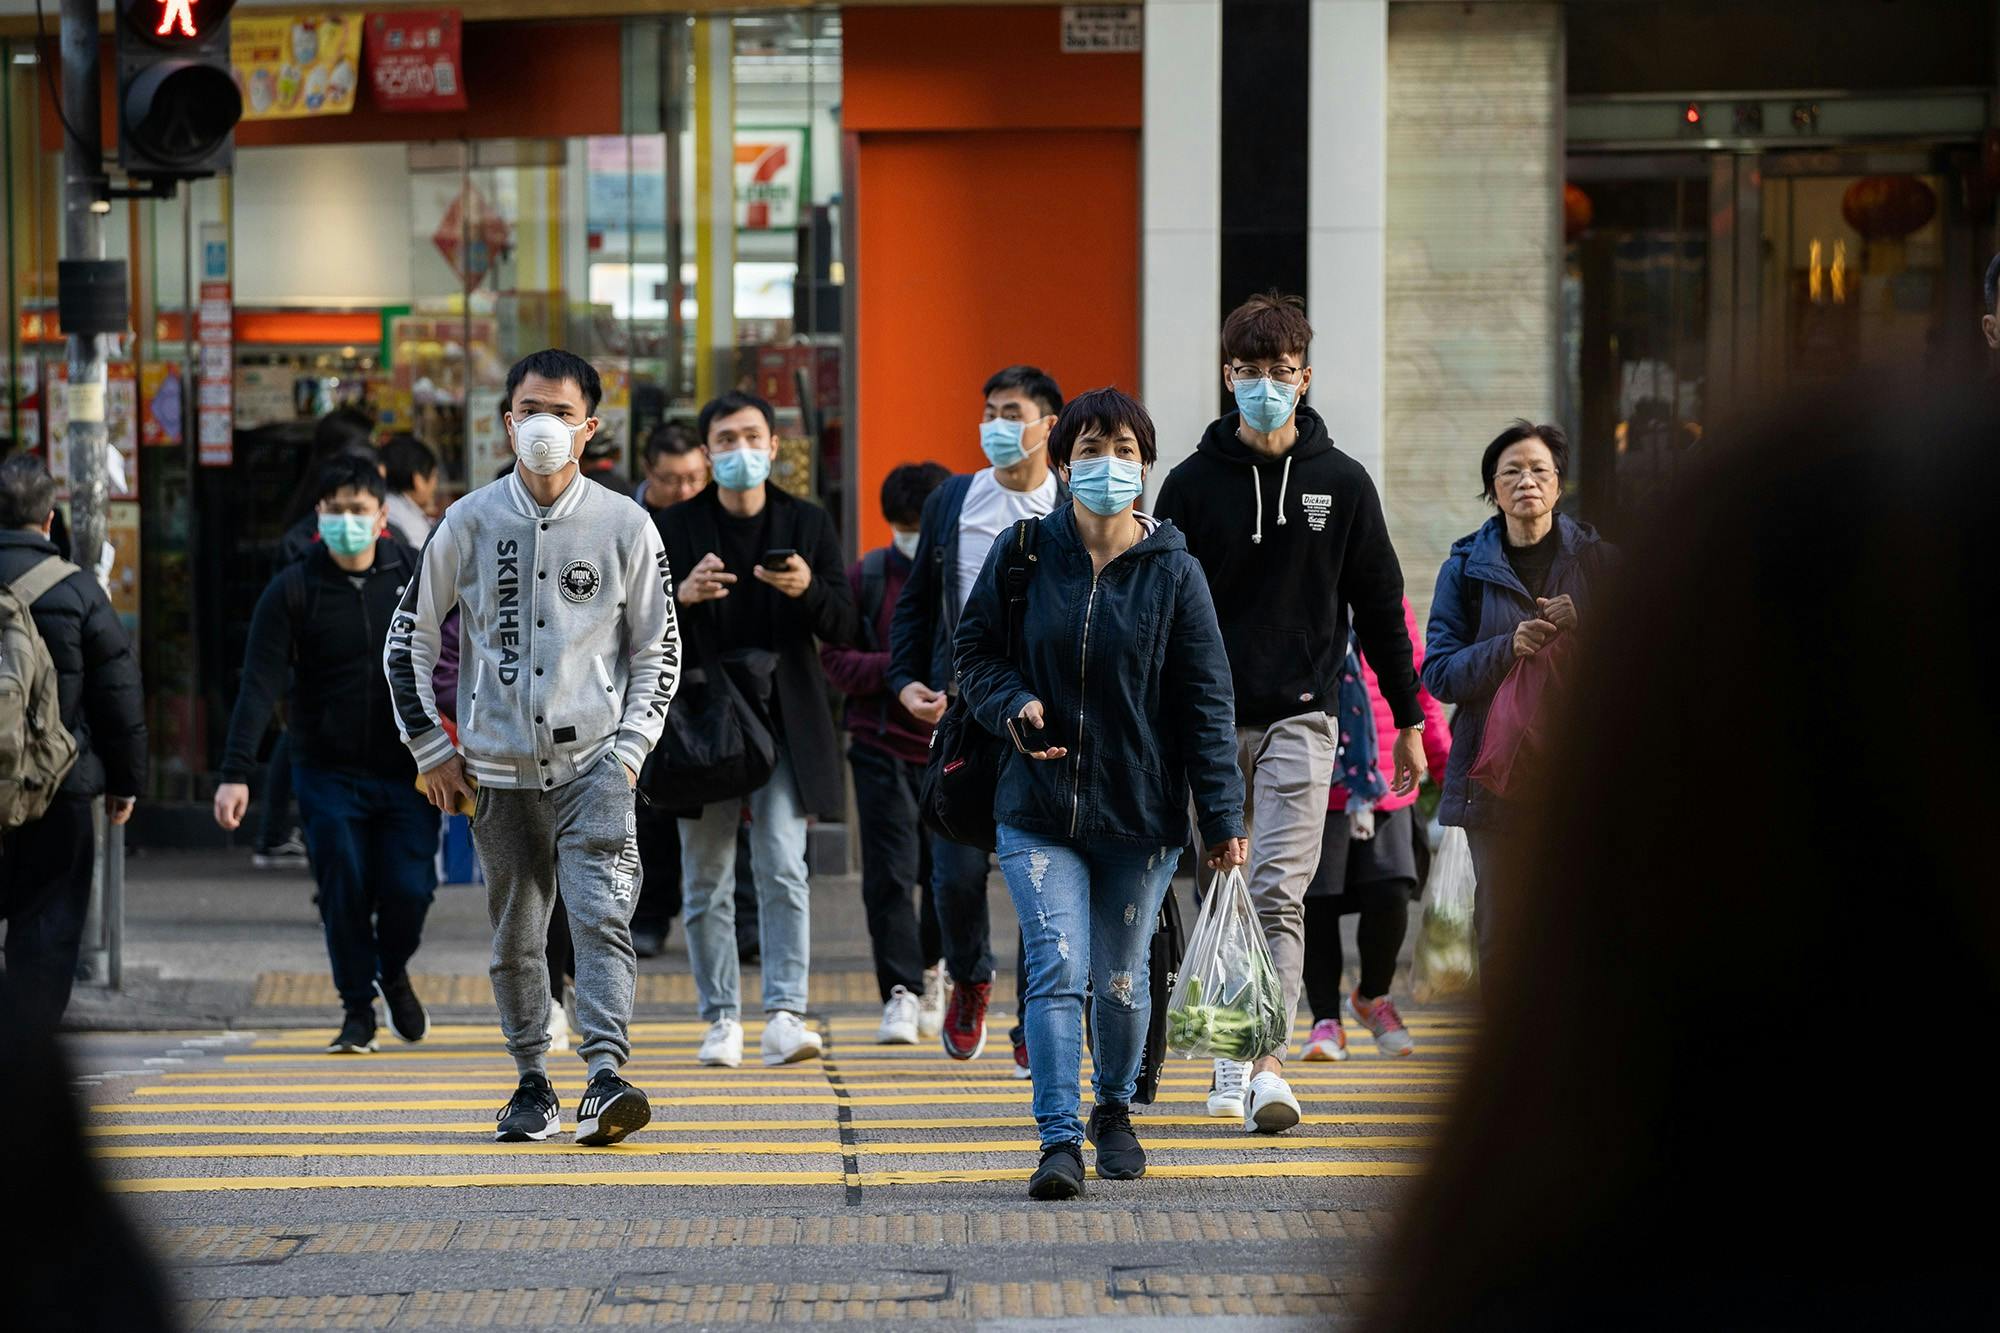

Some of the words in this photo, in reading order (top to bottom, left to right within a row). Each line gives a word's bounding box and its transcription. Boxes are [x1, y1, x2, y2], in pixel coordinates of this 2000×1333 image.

[1303, 495, 1330, 505] Dickies
[497, 540, 520, 686] SKINHEAD
[646, 670, 675, 718] DIV.
[615, 837, 638, 902] RUNNER
